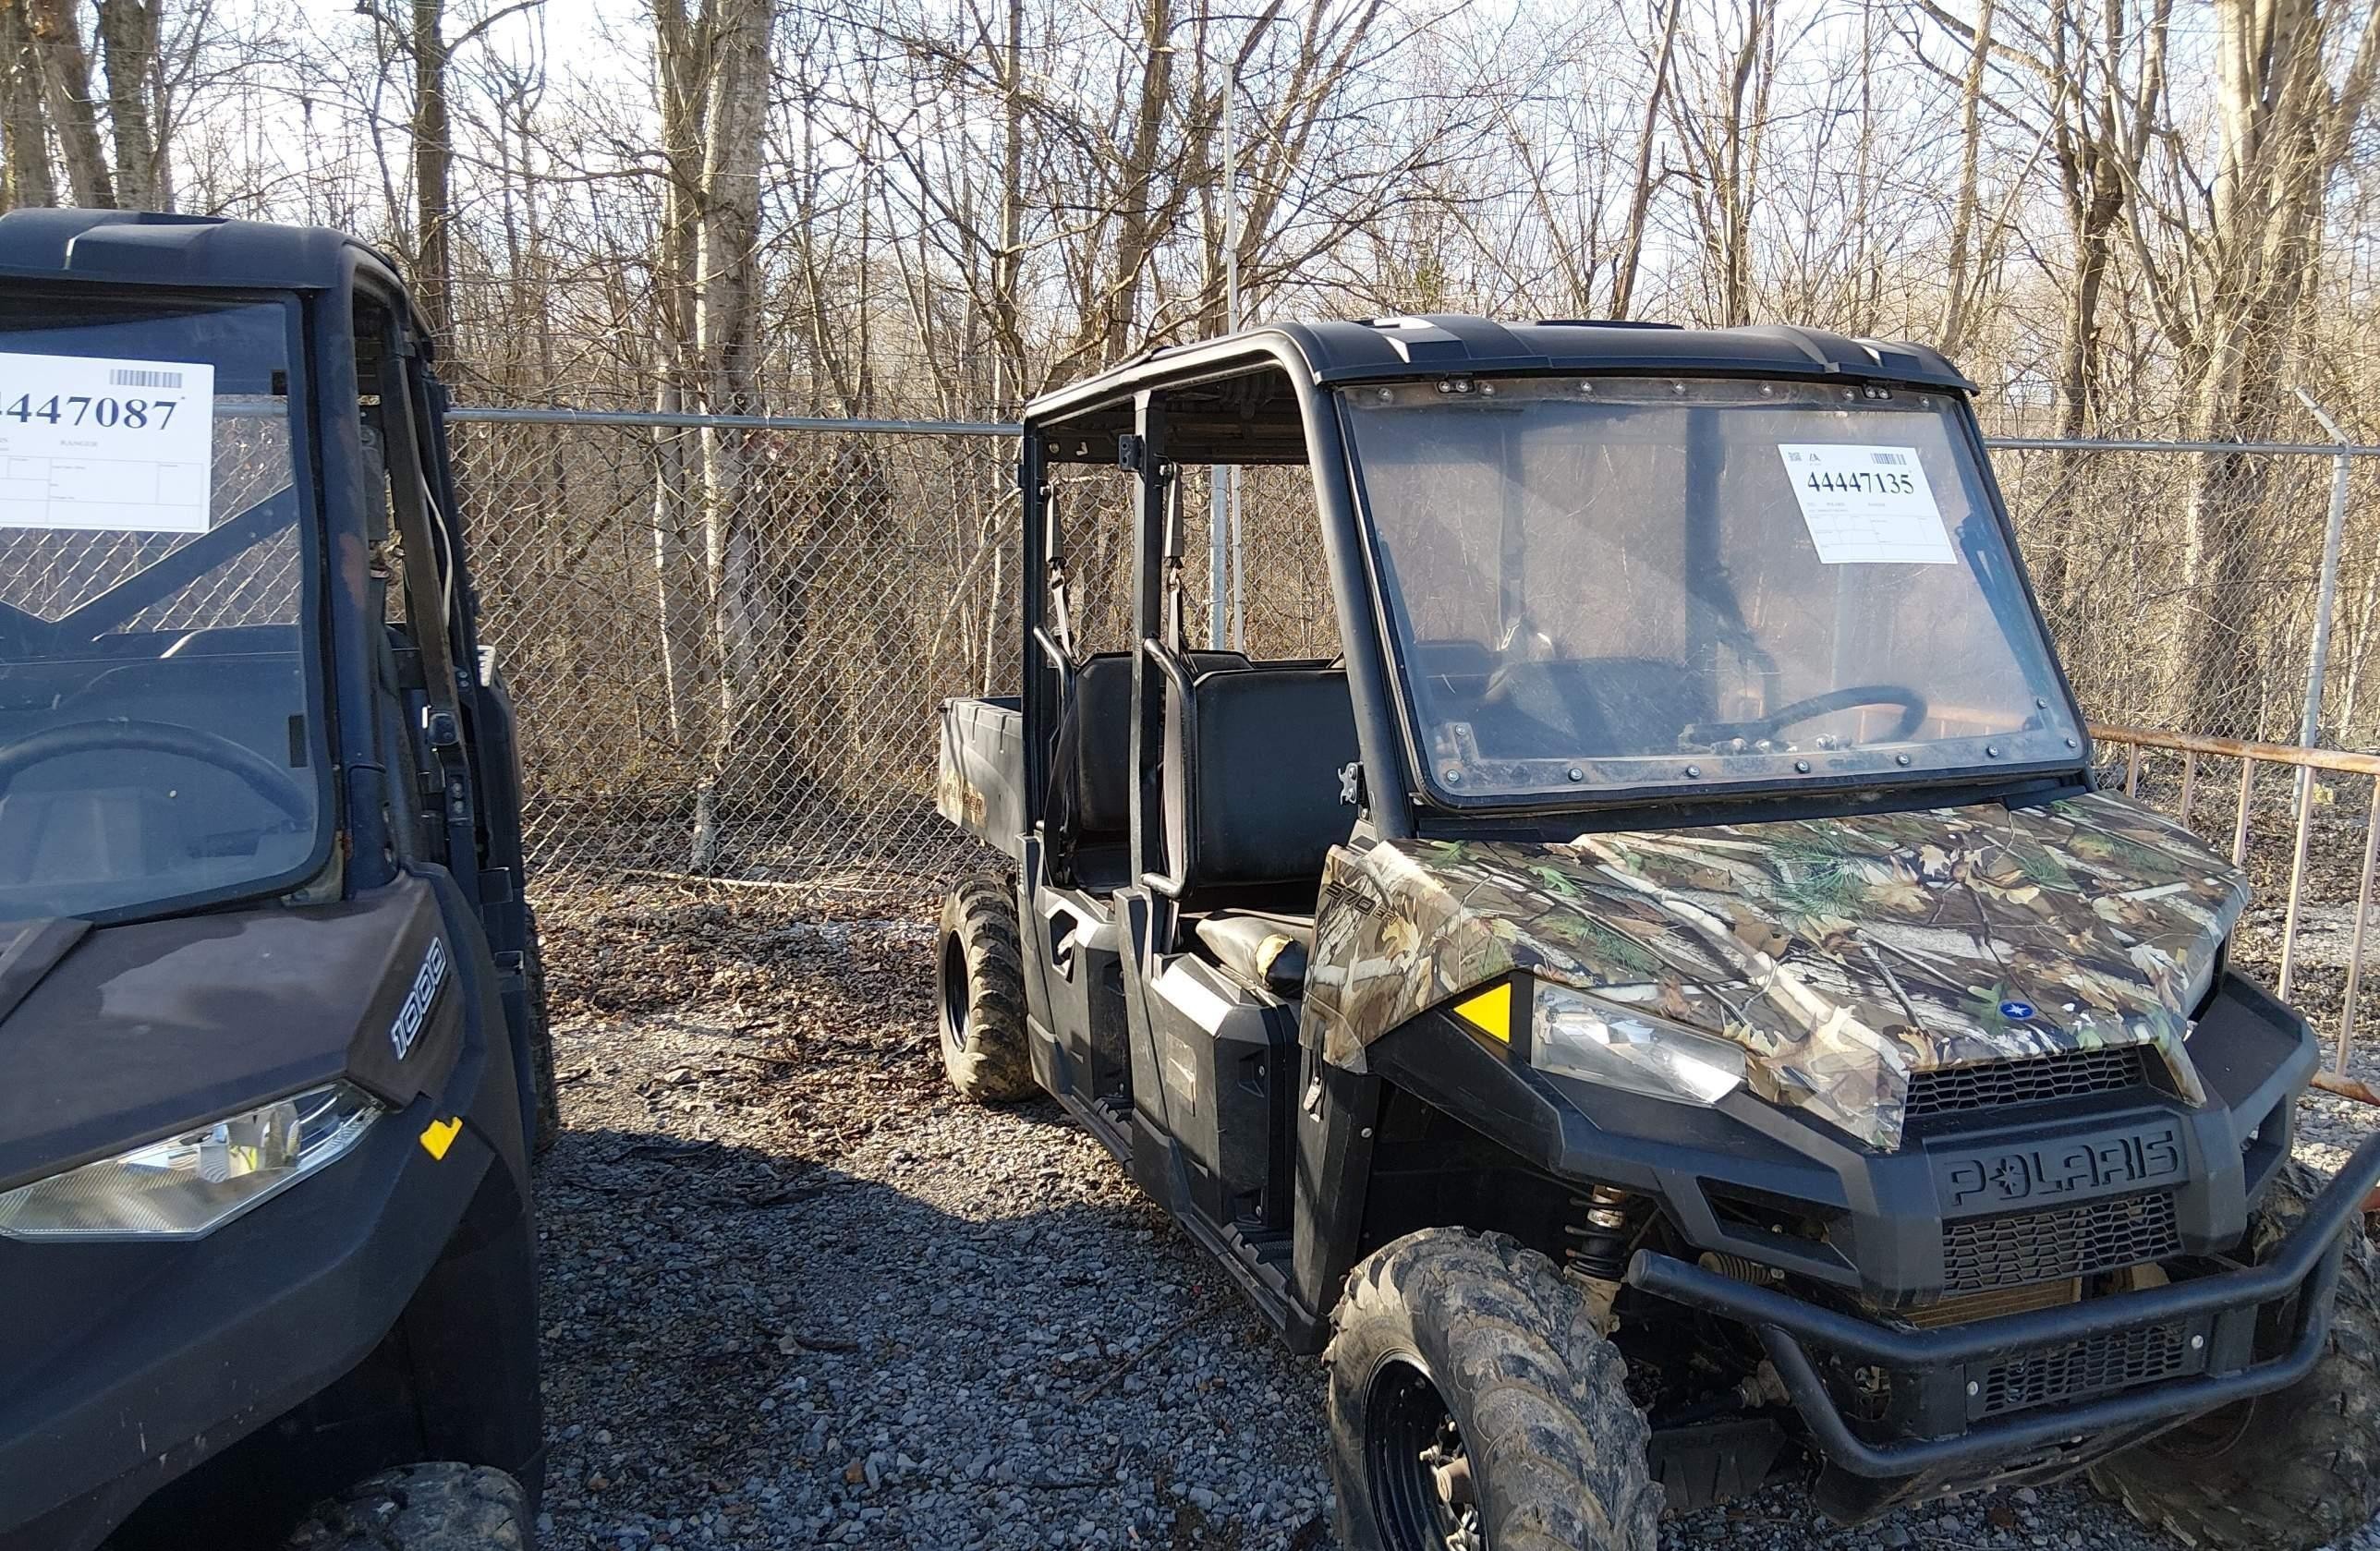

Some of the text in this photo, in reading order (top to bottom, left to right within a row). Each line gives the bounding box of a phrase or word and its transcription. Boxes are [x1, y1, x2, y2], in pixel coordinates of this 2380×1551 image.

[0, 392, 177, 430] 447087
[1807, 471, 1914, 494] 44447135
[1324, 879, 1399, 925] 570 EFI
[390, 936, 448, 1060] 1000
[1944, 1130, 2179, 1207] POLARIS
